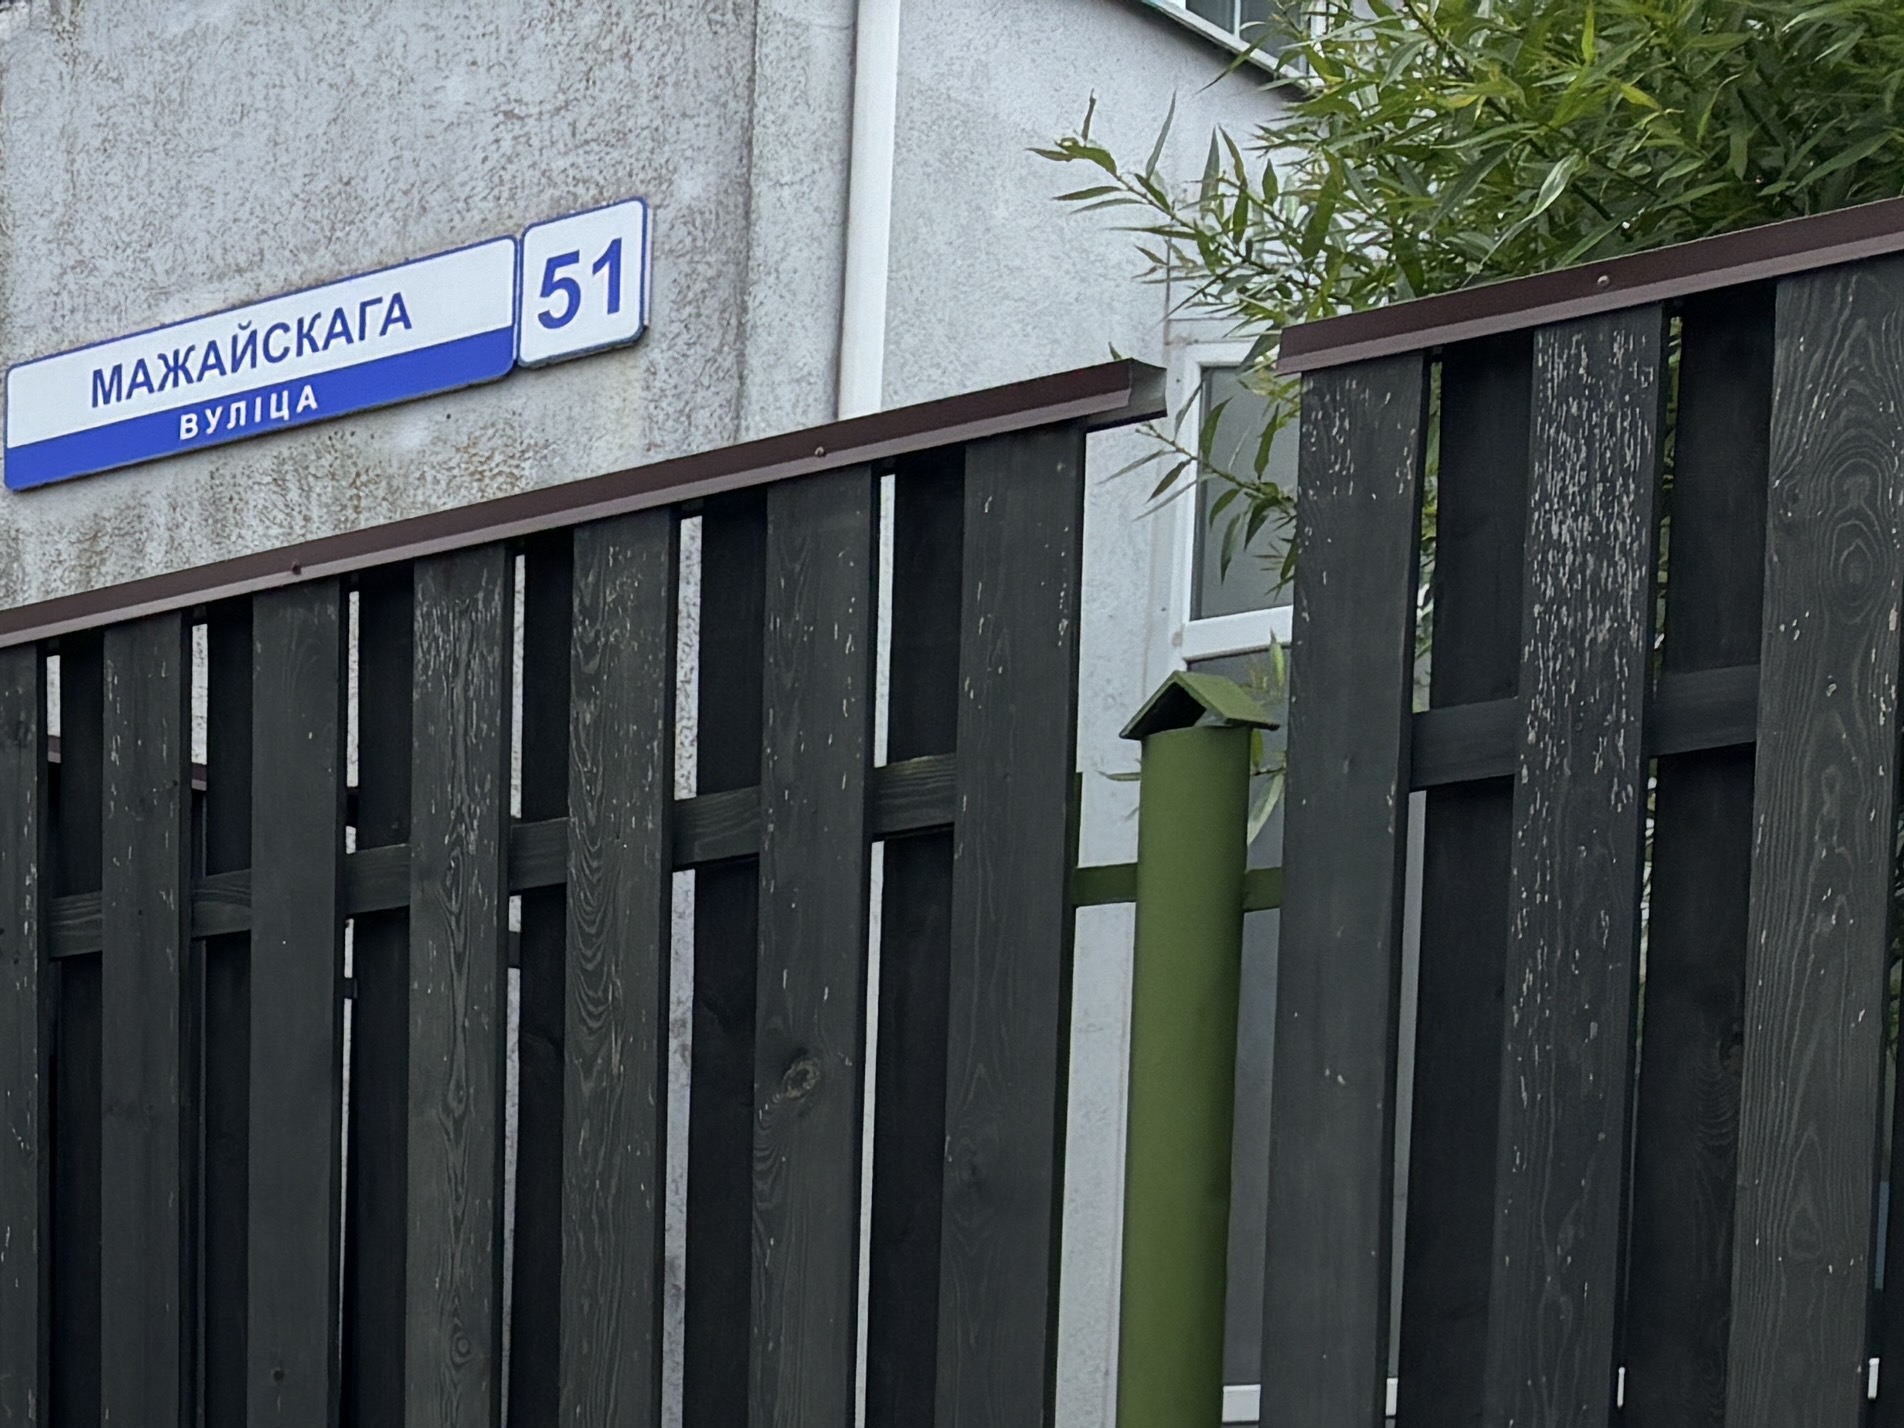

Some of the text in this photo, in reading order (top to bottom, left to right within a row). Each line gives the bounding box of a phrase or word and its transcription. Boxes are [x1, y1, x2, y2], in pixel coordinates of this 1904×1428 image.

[537, 238, 624, 329] 51
[92, 292, 412, 408] МАЖАЙСКАГА
[179, 385, 318, 440] ВУЛІЦА
